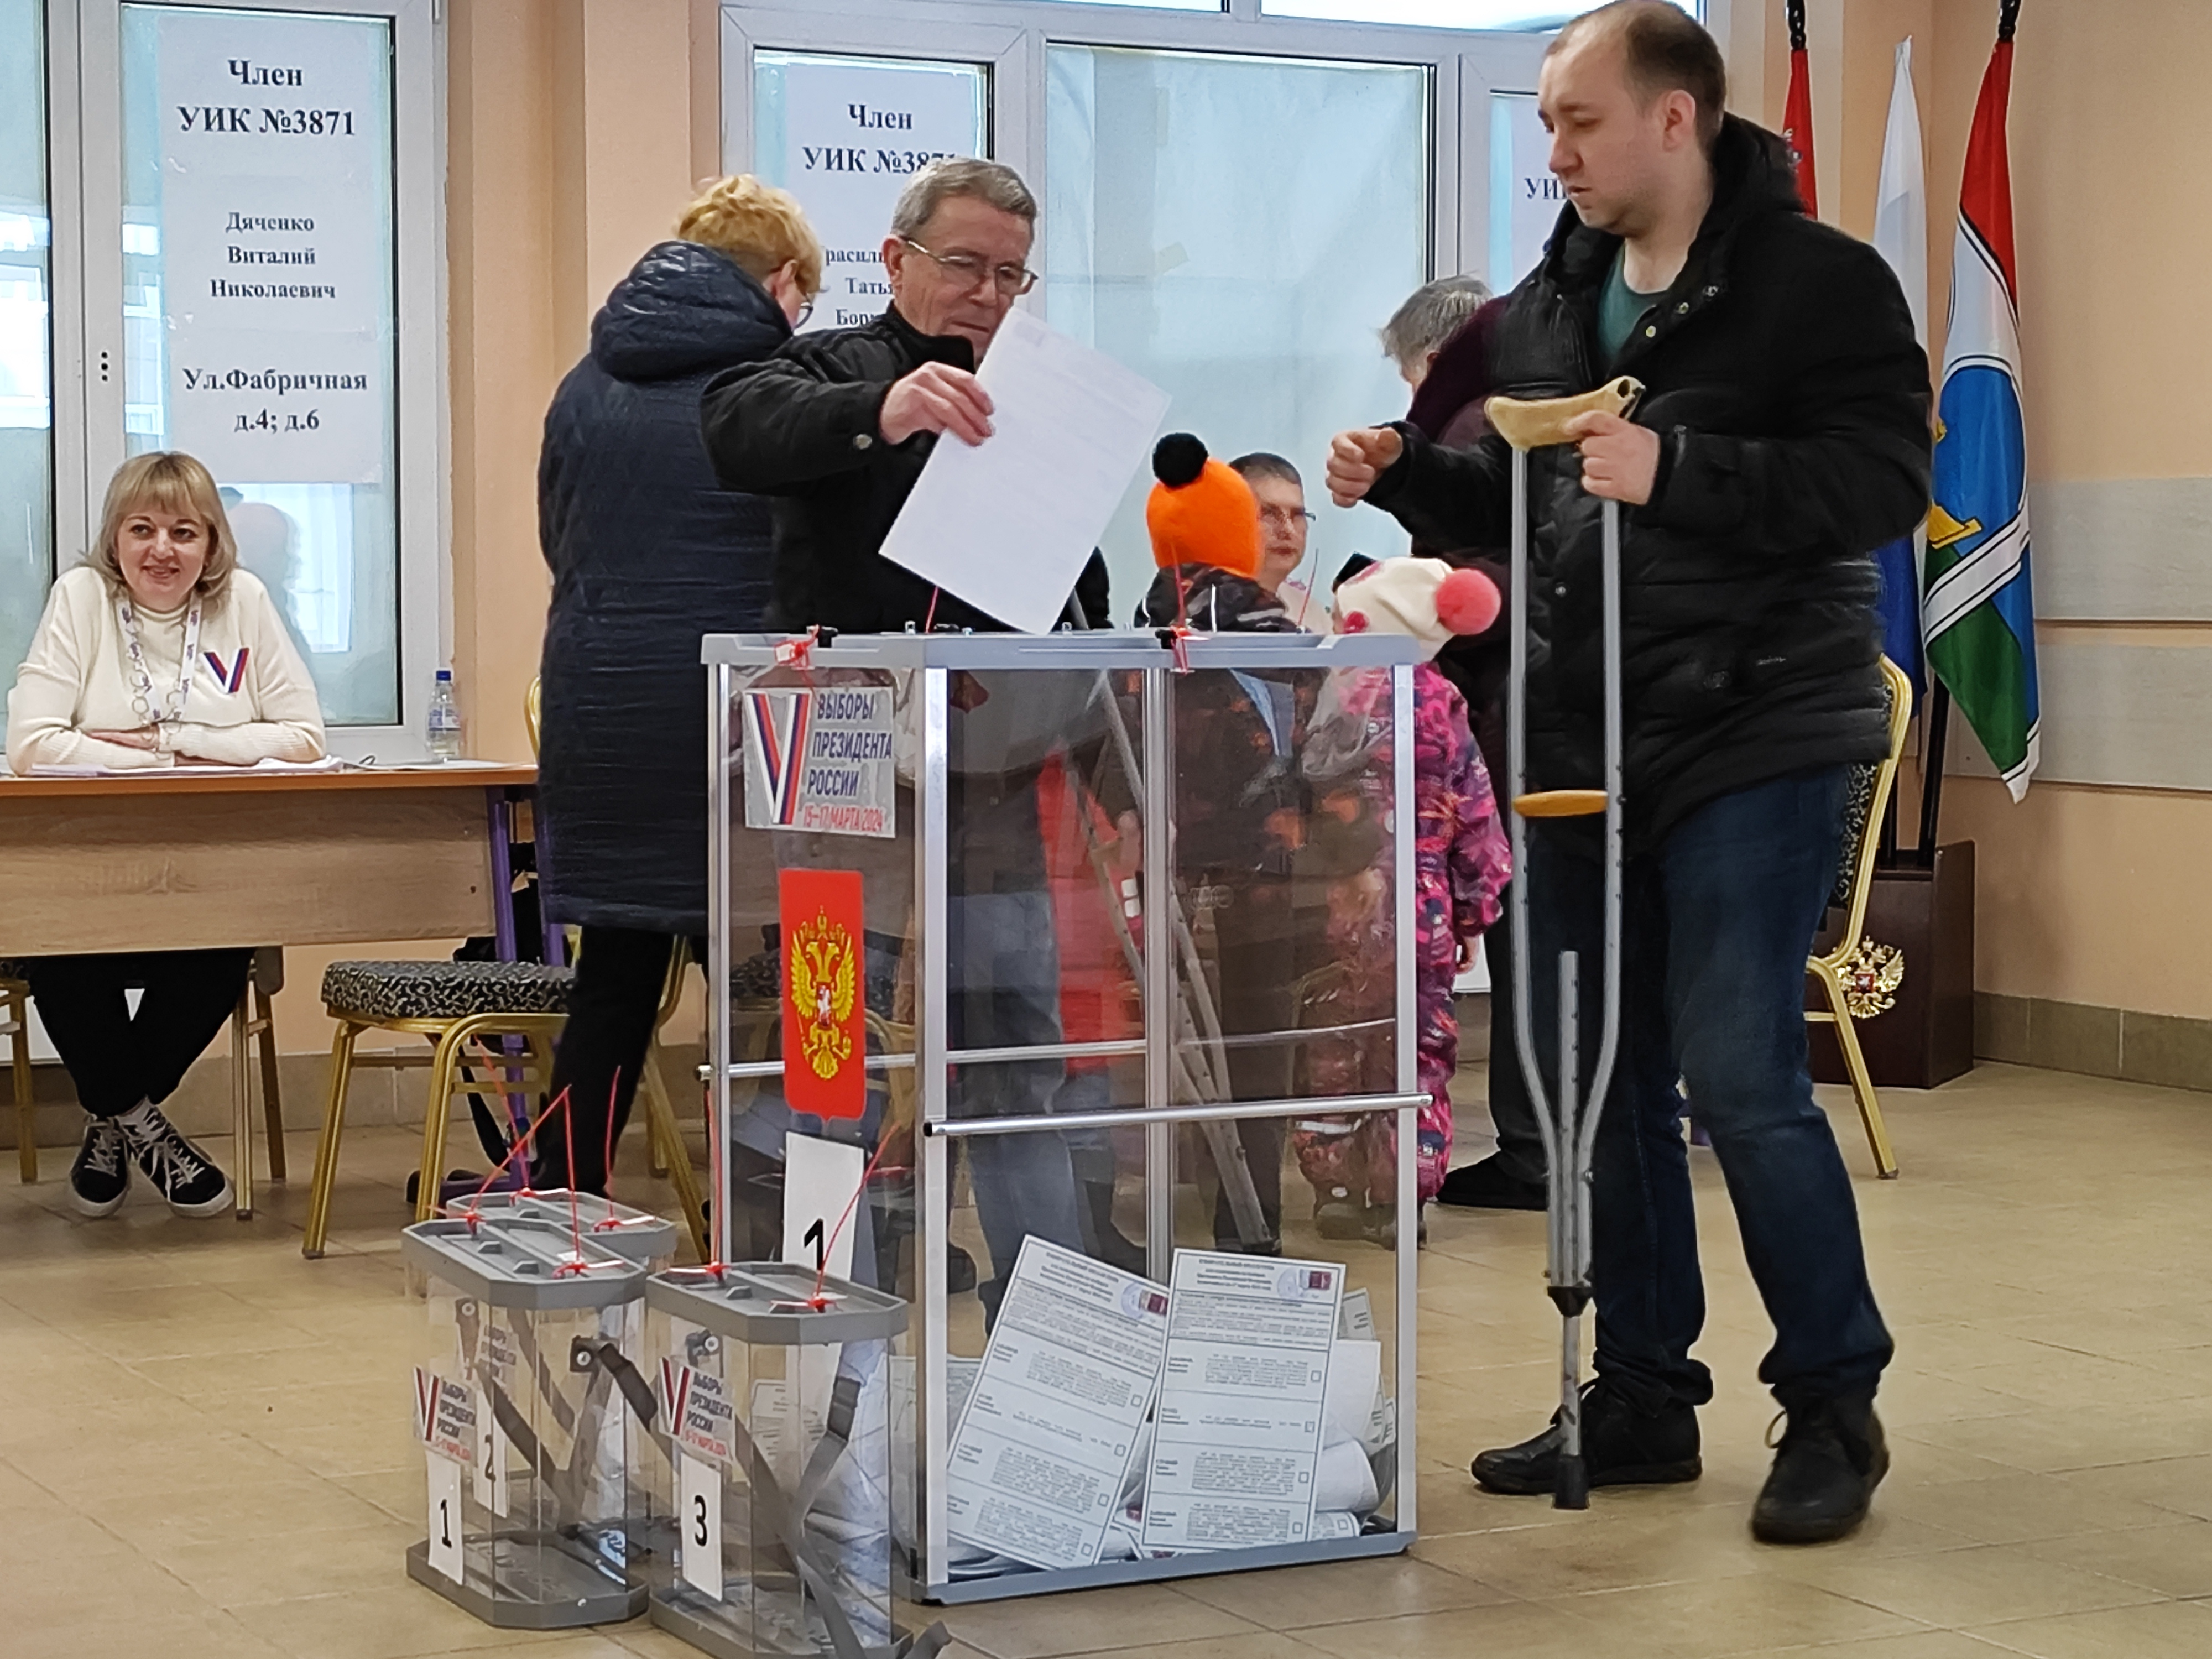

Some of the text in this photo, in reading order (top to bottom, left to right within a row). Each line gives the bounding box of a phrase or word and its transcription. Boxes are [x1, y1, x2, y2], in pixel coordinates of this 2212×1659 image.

[227, 59, 302, 86] Член
[176, 106, 355, 135] УИК №3871
[848, 105, 912, 130] Член
[802, 147, 866, 171] УИК
[226, 212, 314, 233] Дяченко
[227, 246, 315, 264] Виталий
[210, 279, 335, 298] Николаевич
[836, 309, 875, 326] Бор
[182, 368, 367, 395] Ул.Фабричная
[234, 408, 320, 434] д.4; д.6
[817, 693, 875, 719] ВЫБОРЫ
[812, 731, 892, 763] ПРЕЗИДЕНТА
[807, 769, 859, 796] РОССИИ
[804, 1218, 823, 1271] 1
[440, 1499, 452, 1549] 1
[694, 1495, 707, 1547] 3
